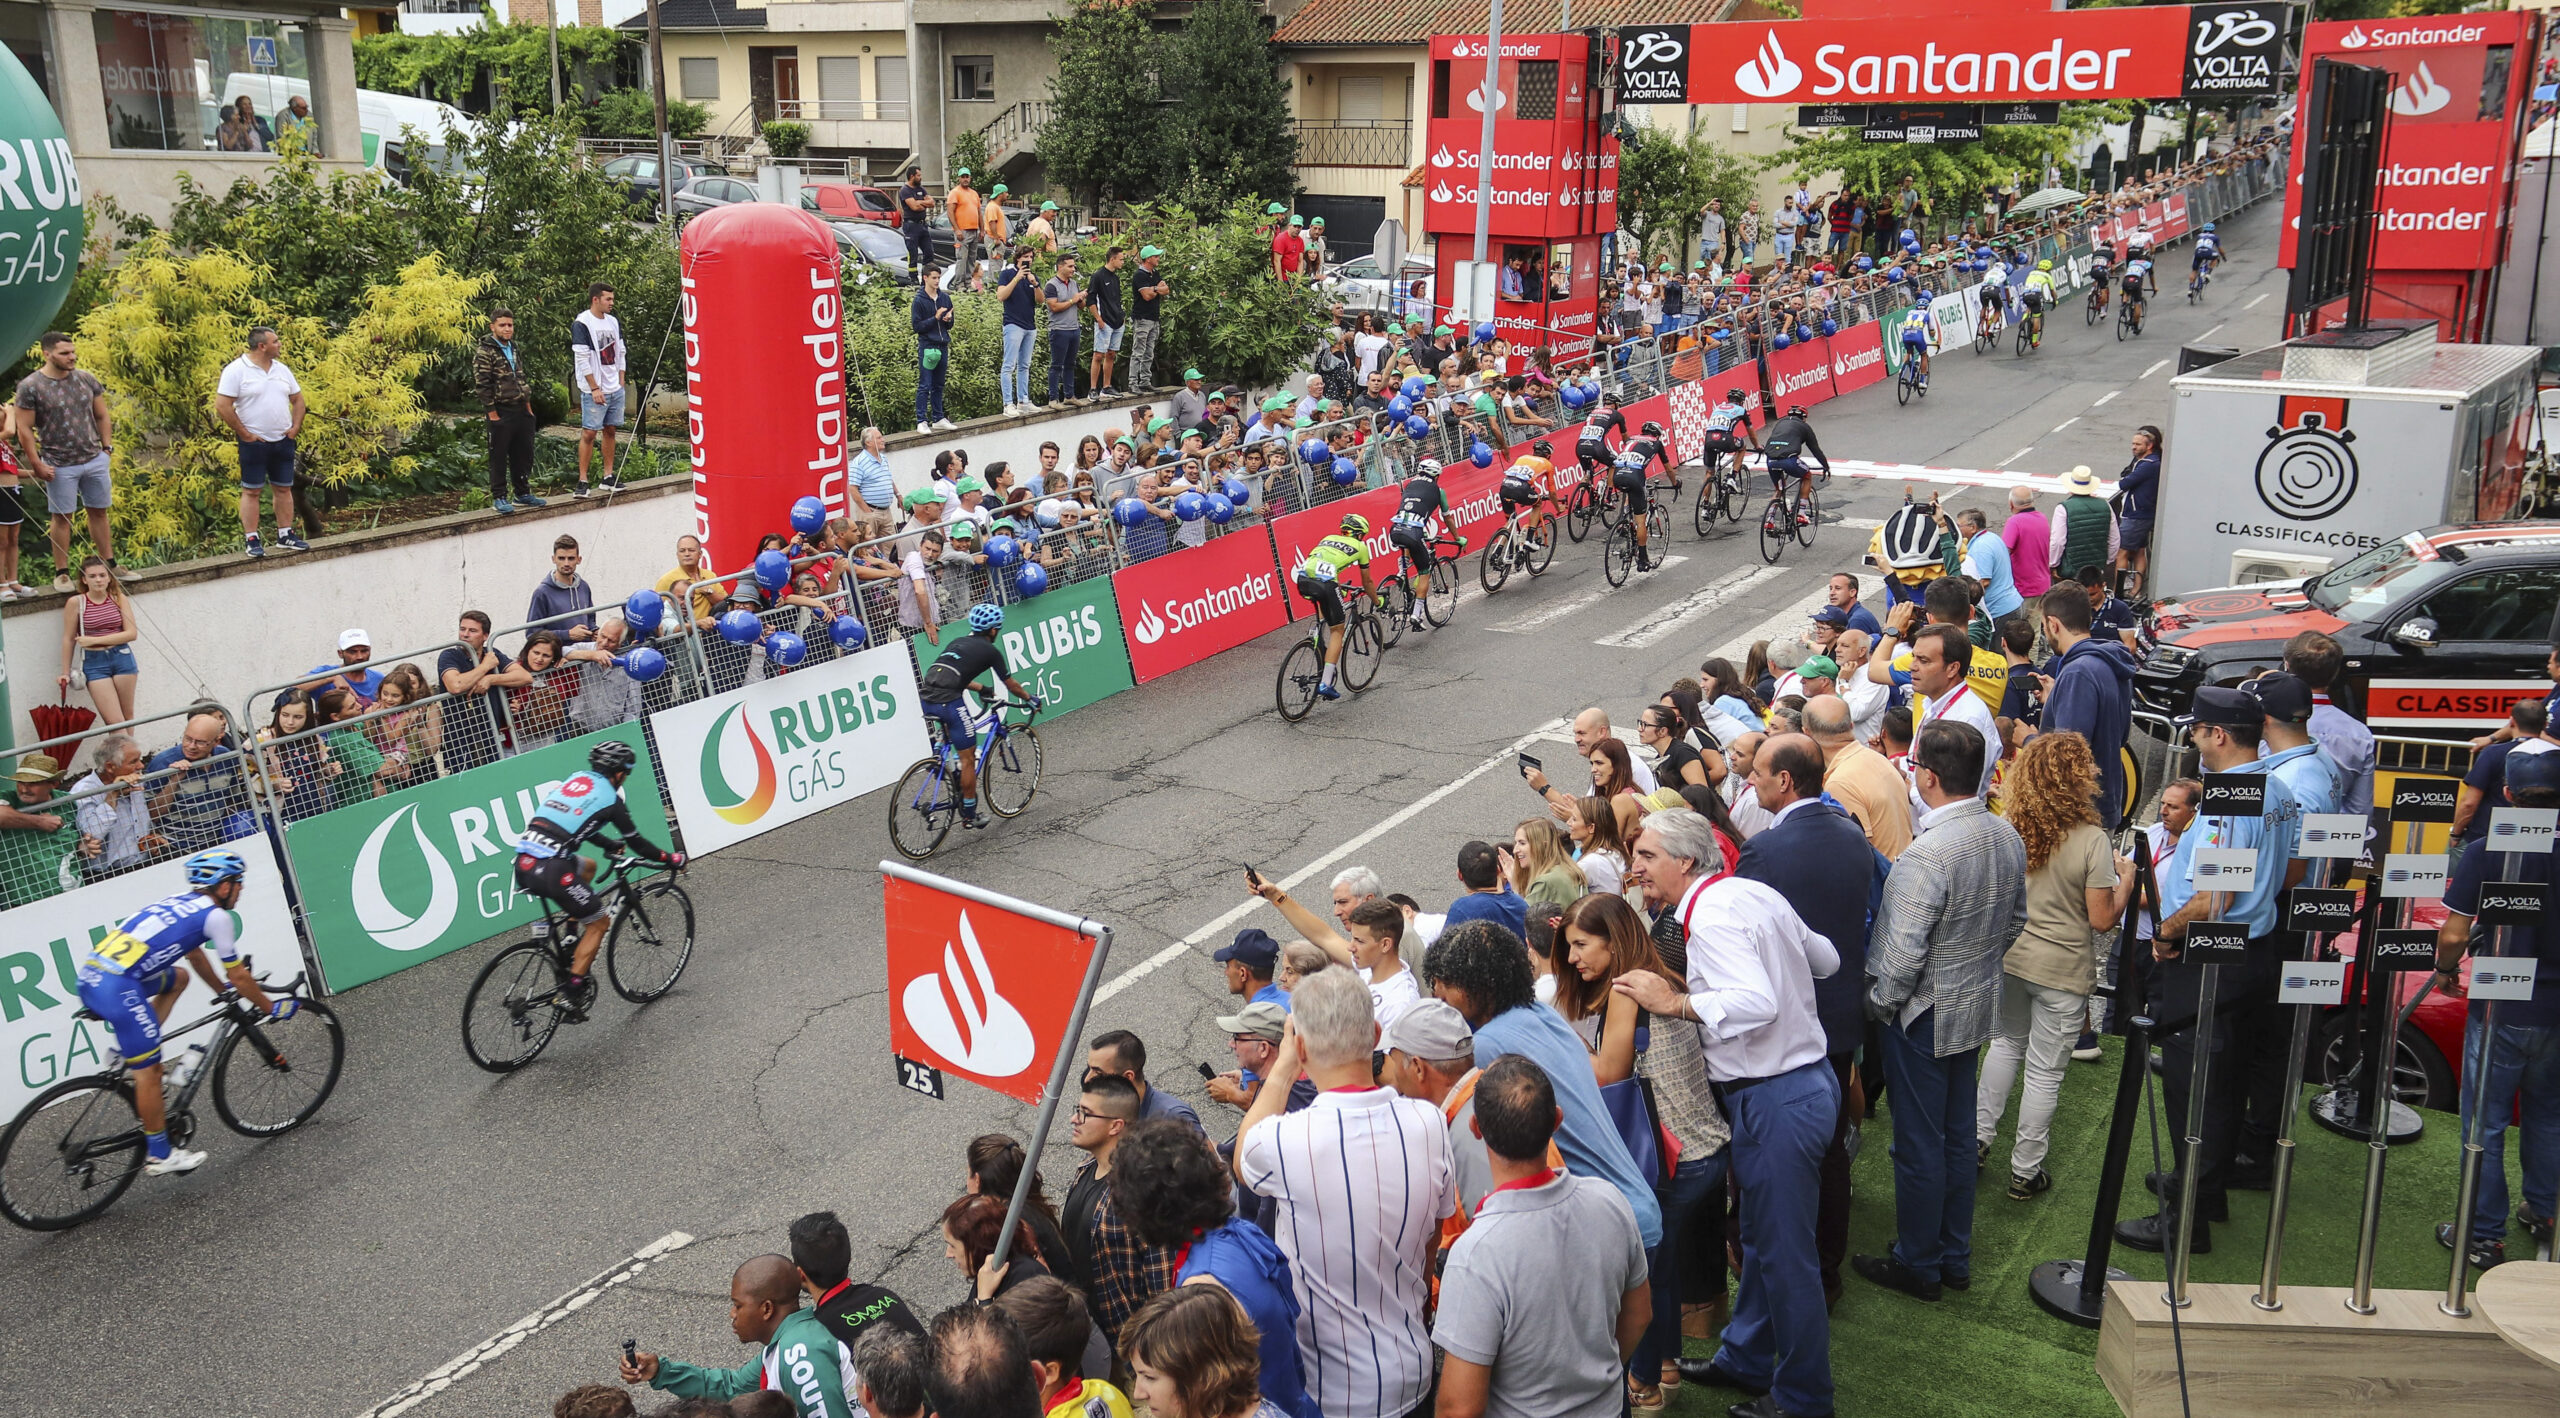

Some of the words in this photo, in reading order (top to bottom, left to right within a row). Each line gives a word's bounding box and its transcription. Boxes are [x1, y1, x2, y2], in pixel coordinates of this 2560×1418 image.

[2370, 24, 2486, 47] Santander
[1812, 38, 2132, 95] Santander
[2193, 55, 2271, 78] VOLTA
[1623, 70, 1681, 89] VOLTA
[2190, 80, 2201, 89] A
[2203, 77, 2269, 88] PORTUGAL
[1623, 91, 1631, 99] A
[1632, 89, 1681, 99] PORTUGAL
[1816, 115, 1845, 123] FESTINA
[2005, 112, 2037, 121] FESTINA
[1864, 129, 1904, 139] FESTINA
[1908, 127, 1933, 136] META
[1937, 128, 1979, 139] FESTINA
[1456, 149, 1553, 170] Satander
[2375, 162, 2494, 187] ntander
[1455, 184, 1550, 207] Satander
[2377, 207, 2487, 231] ntander
[1559, 311, 1594, 330] Santander
[1844, 346, 1882, 373] Santander
[1784, 363, 1829, 393] Santander
[1438, 489, 1502, 534] Santande
[2216, 521, 2382, 549] CLASSIFICAÇÕES
[1317, 565, 1333, 576] 44
[1165, 572, 1272, 635] Santander
[1002, 604, 1102, 674] RUBiS
[769, 674, 897, 755] RUBiS
[788, 749, 845, 803] GÁS
[567, 781, 588, 793] RP
[2231, 787, 2262, 796] VOLTA
[2422, 792, 2455, 802] VOLTA
[2520, 826, 2553, 834] RTP
[2223, 866, 2252, 874] RTP
[2413, 872, 2444, 880] RTP
[2319, 903, 2351, 912] VOLTA
[2508, 897, 2541, 906] VOLTA
[2214, 936, 2245, 946] VOLTA
[2402, 943, 2434, 951] VOLTA
[2309, 979, 2340, 987] RTP
[2500, 975, 2531, 983] RTP
